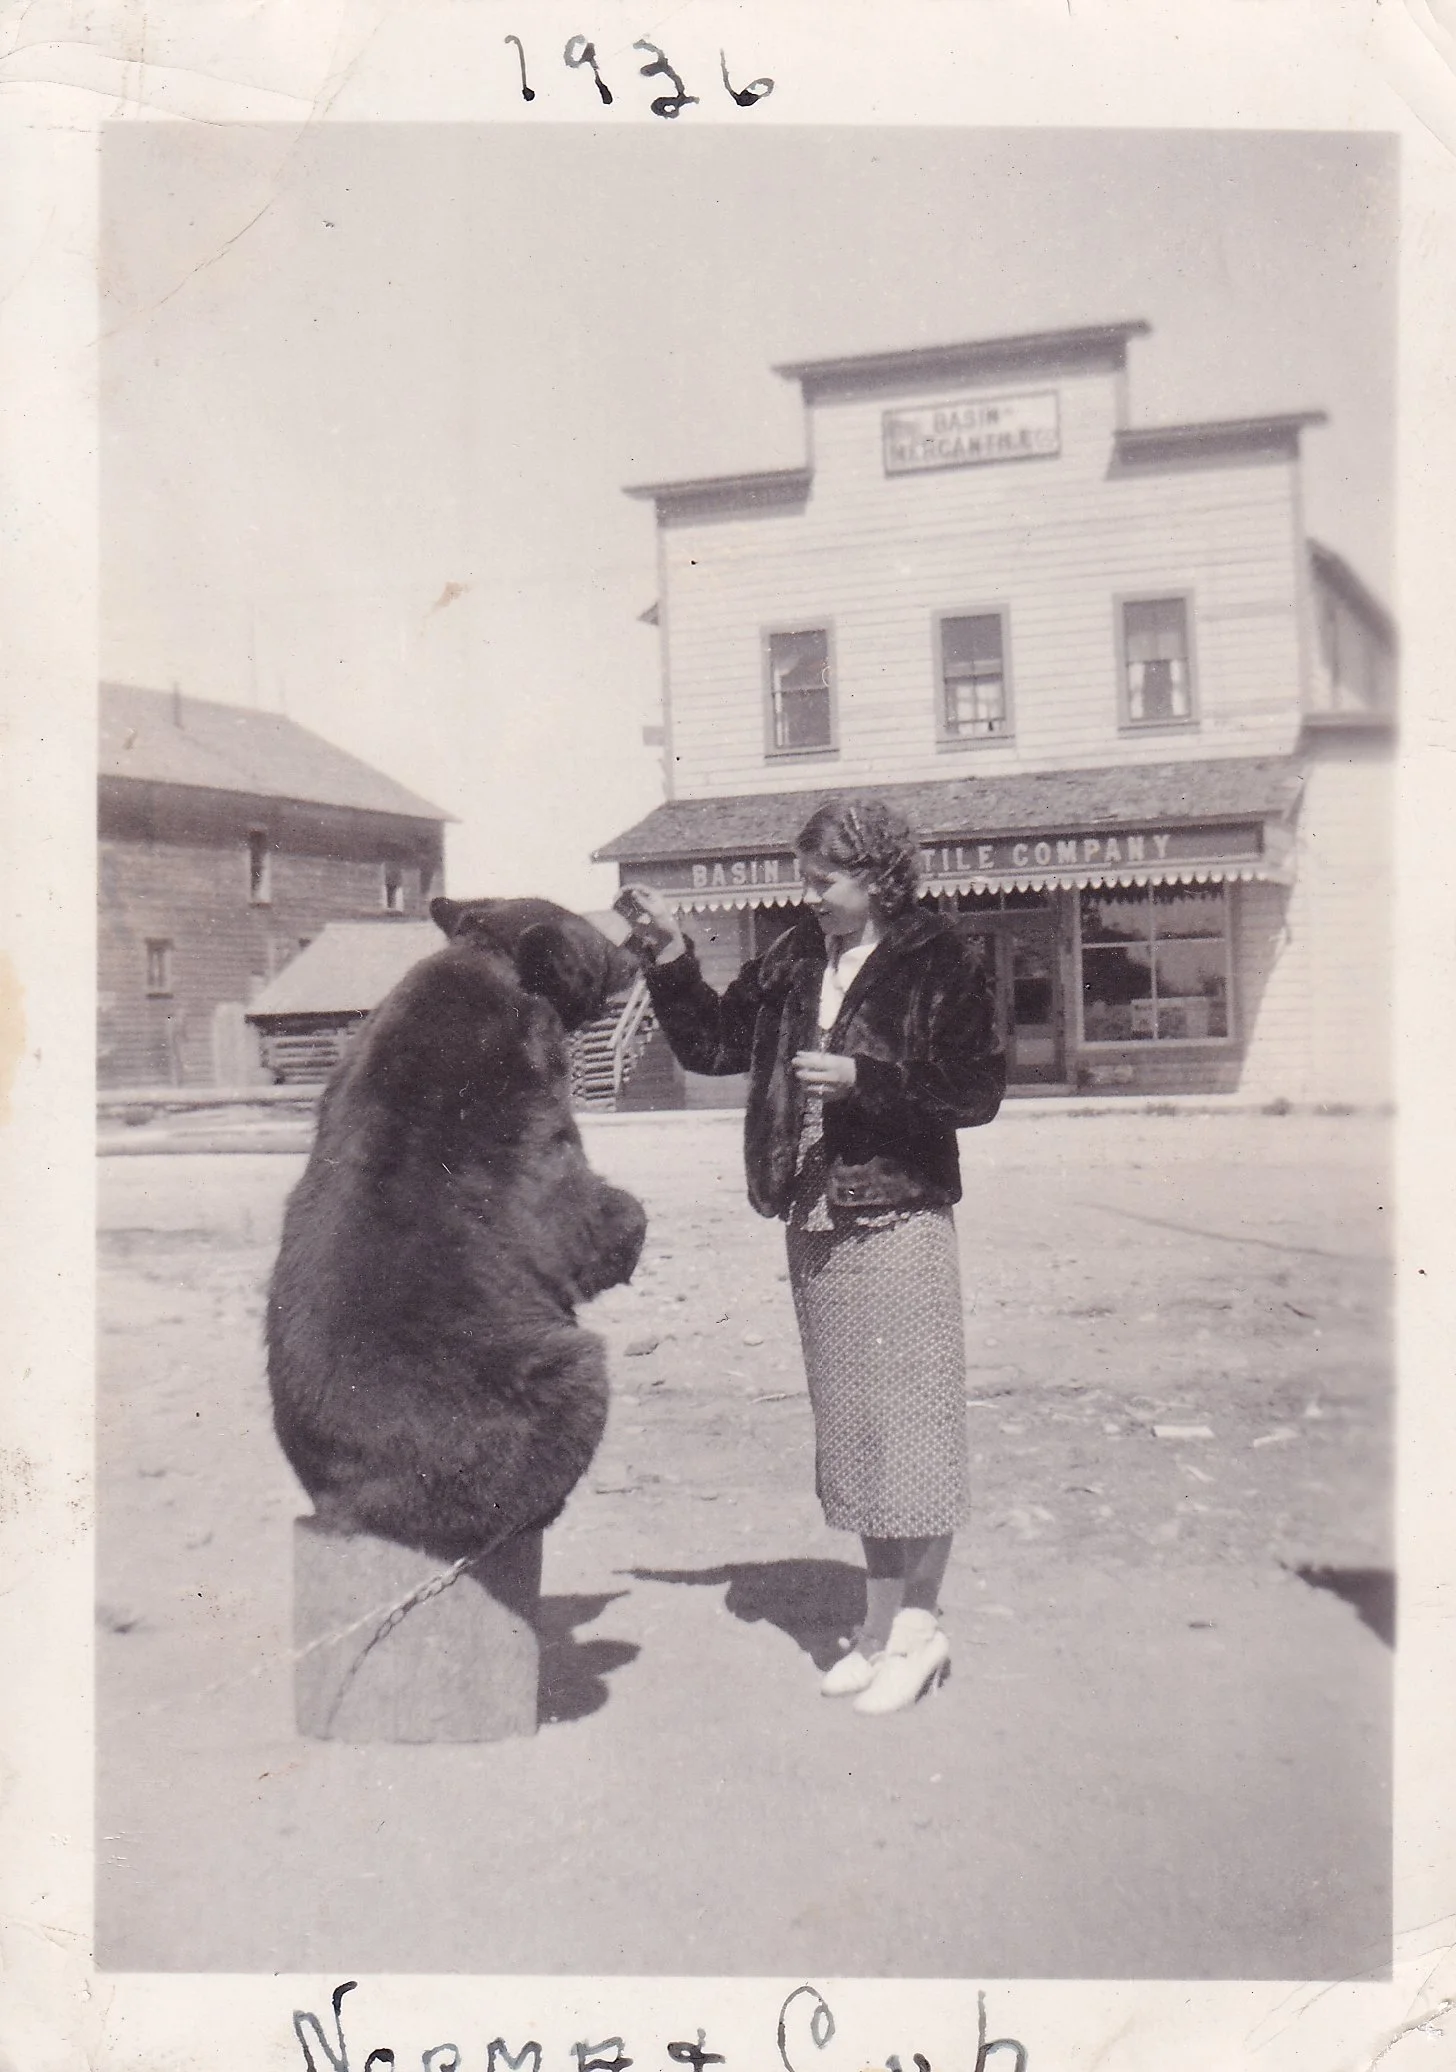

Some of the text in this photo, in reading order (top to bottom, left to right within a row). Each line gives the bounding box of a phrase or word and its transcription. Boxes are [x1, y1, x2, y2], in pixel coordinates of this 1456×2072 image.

[504, 34, 776, 119] 1936
[933, 406, 1000, 435] BASIN
[692, 859, 779, 888] BASIN
[1012, 834, 1171, 867] COMPANY
